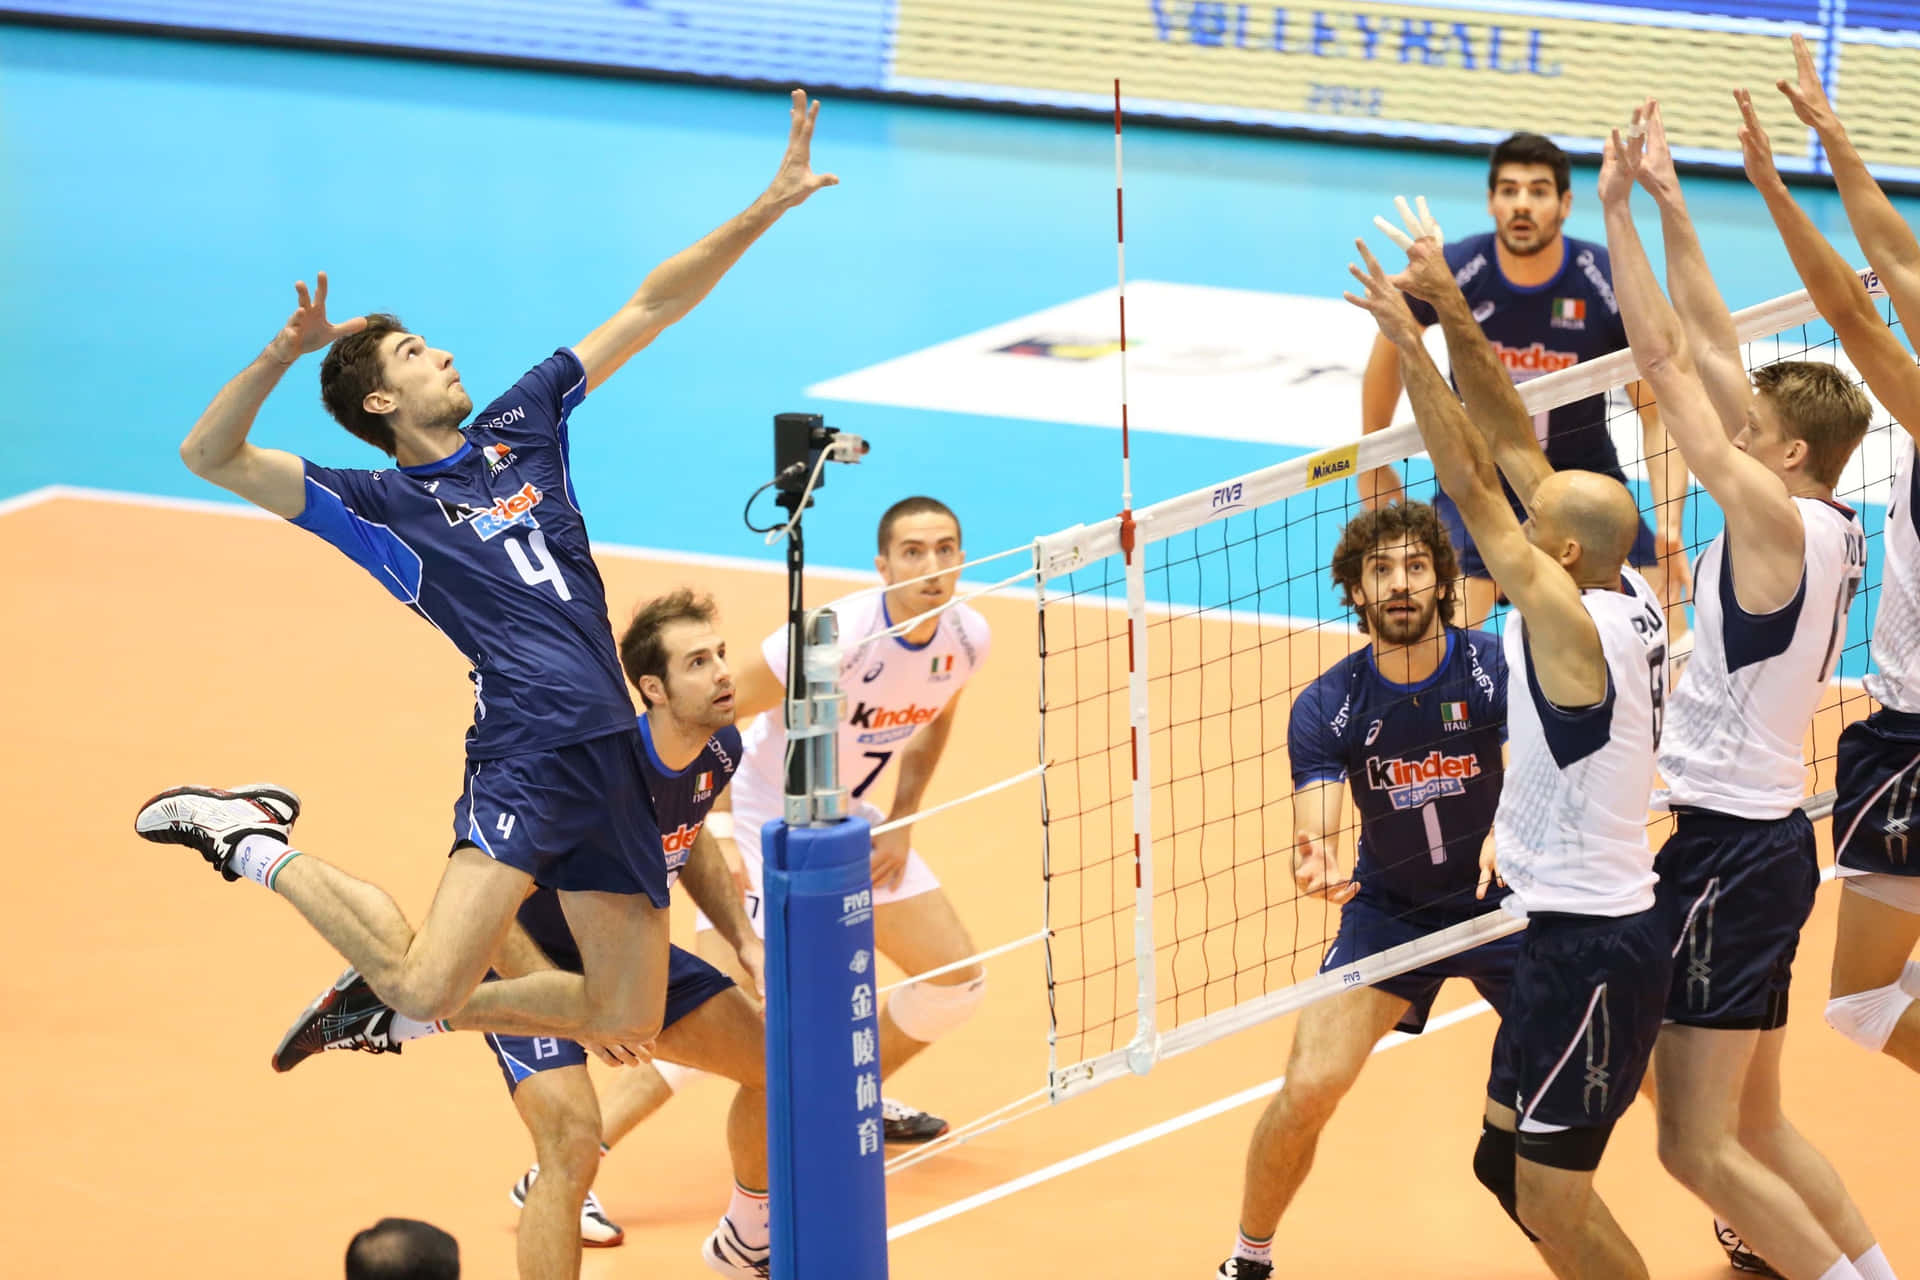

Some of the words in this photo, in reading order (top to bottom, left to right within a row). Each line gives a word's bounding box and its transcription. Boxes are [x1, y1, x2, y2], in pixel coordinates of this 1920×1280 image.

[503, 529, 572, 601] 4
[851, 751, 893, 799] 7
[496, 812, 516, 840] 4
[1422, 801, 1448, 865] 1
[746, 894, 760, 919] 7
[533, 1037, 559, 1060] 13
